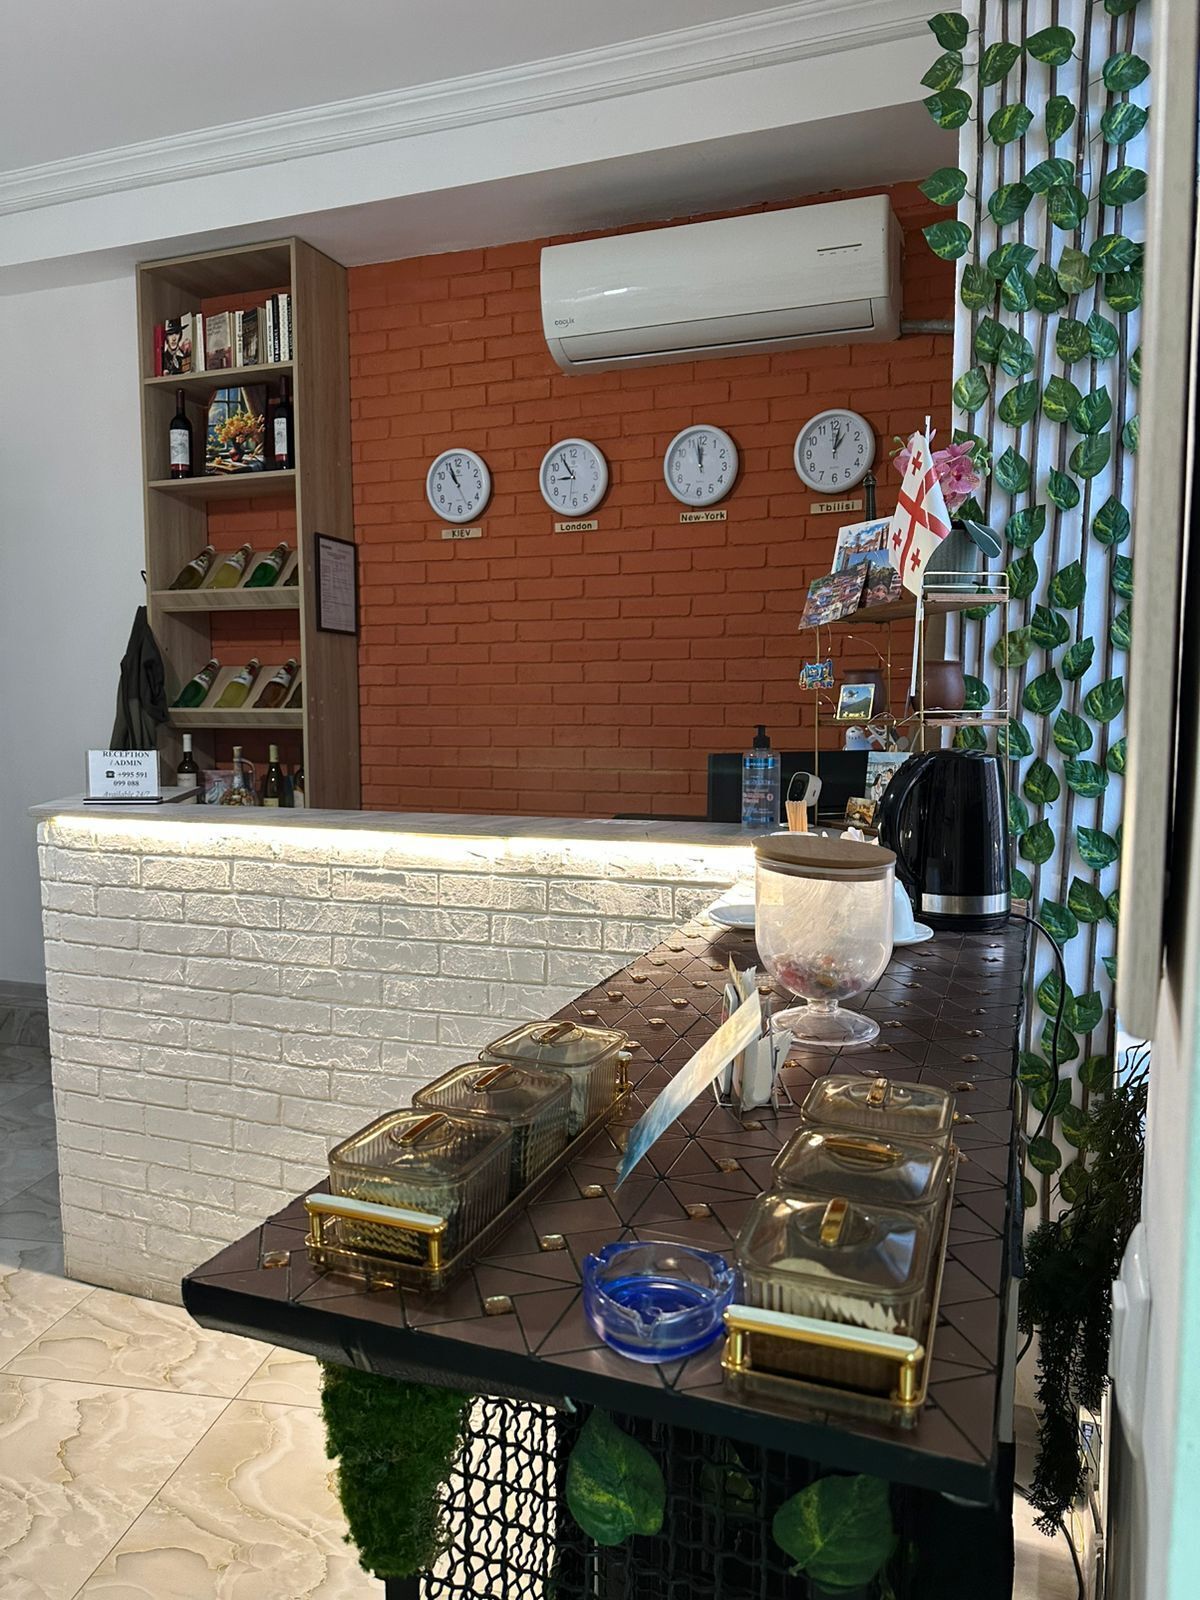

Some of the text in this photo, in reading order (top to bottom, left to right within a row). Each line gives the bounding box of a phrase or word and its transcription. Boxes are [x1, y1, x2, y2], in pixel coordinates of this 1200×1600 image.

[830, 420, 839, 430] 12
[846, 423, 850, 432] 1
[818, 425, 826, 435] 11
[699, 435, 707, 445] 12
[854, 431, 860, 441] 2
[688, 439, 695, 448] 11
[713, 440, 716, 448] 1
[808, 436, 818, 446] 10
[570, 449, 577, 458] 12
[678, 448, 686, 458] 10
[858, 444, 864, 454] 3
[560, 453, 566, 462] 11
[583, 452, 586, 460] 1
[720, 449, 725, 459] 2
[806, 450, 812, 460] 9
[454, 458, 462, 467] 12
[467, 461, 470, 469] 1
[590, 460, 595, 469] 2
[675, 461, 681, 471] 9
[722, 462, 727, 471] 3
[810, 462, 815, 472] 8
[854, 458, 860, 467] 4
[551, 463, 559, 472] 10
[437, 472, 445, 480] 10
[473, 469, 478, 478] 2
[593, 472, 598, 480] 3
[819, 471, 824, 480] 7
[844, 468, 850, 478] 5
[550, 476, 555, 484] 9
[678, 474, 683, 483] 8
[717, 474, 723, 483] 4
[831, 473, 838, 483] 6
[437, 484, 441, 492] 9
[476, 480, 482, 489] 3
[590, 484, 596, 492] 4
[686, 484, 691, 493] 7
[708, 484, 714, 493] 5
[553, 487, 559, 496] 8
[696, 487, 702, 496] 6
[440, 495, 445, 503] 8
[474, 492, 480, 501] 4
[562, 495, 566, 504] 7
[583, 493, 588, 502] 5
[448, 502, 452, 511] 7
[467, 501, 472, 510] 5
[572, 498, 578, 506] 6
[457, 505, 463, 514] 6
[818, 502, 855, 512] Tbilisi
[681, 512, 725, 522] New-York
[560, 522, 592, 531] London
[452, 530, 471, 538] KIEV
